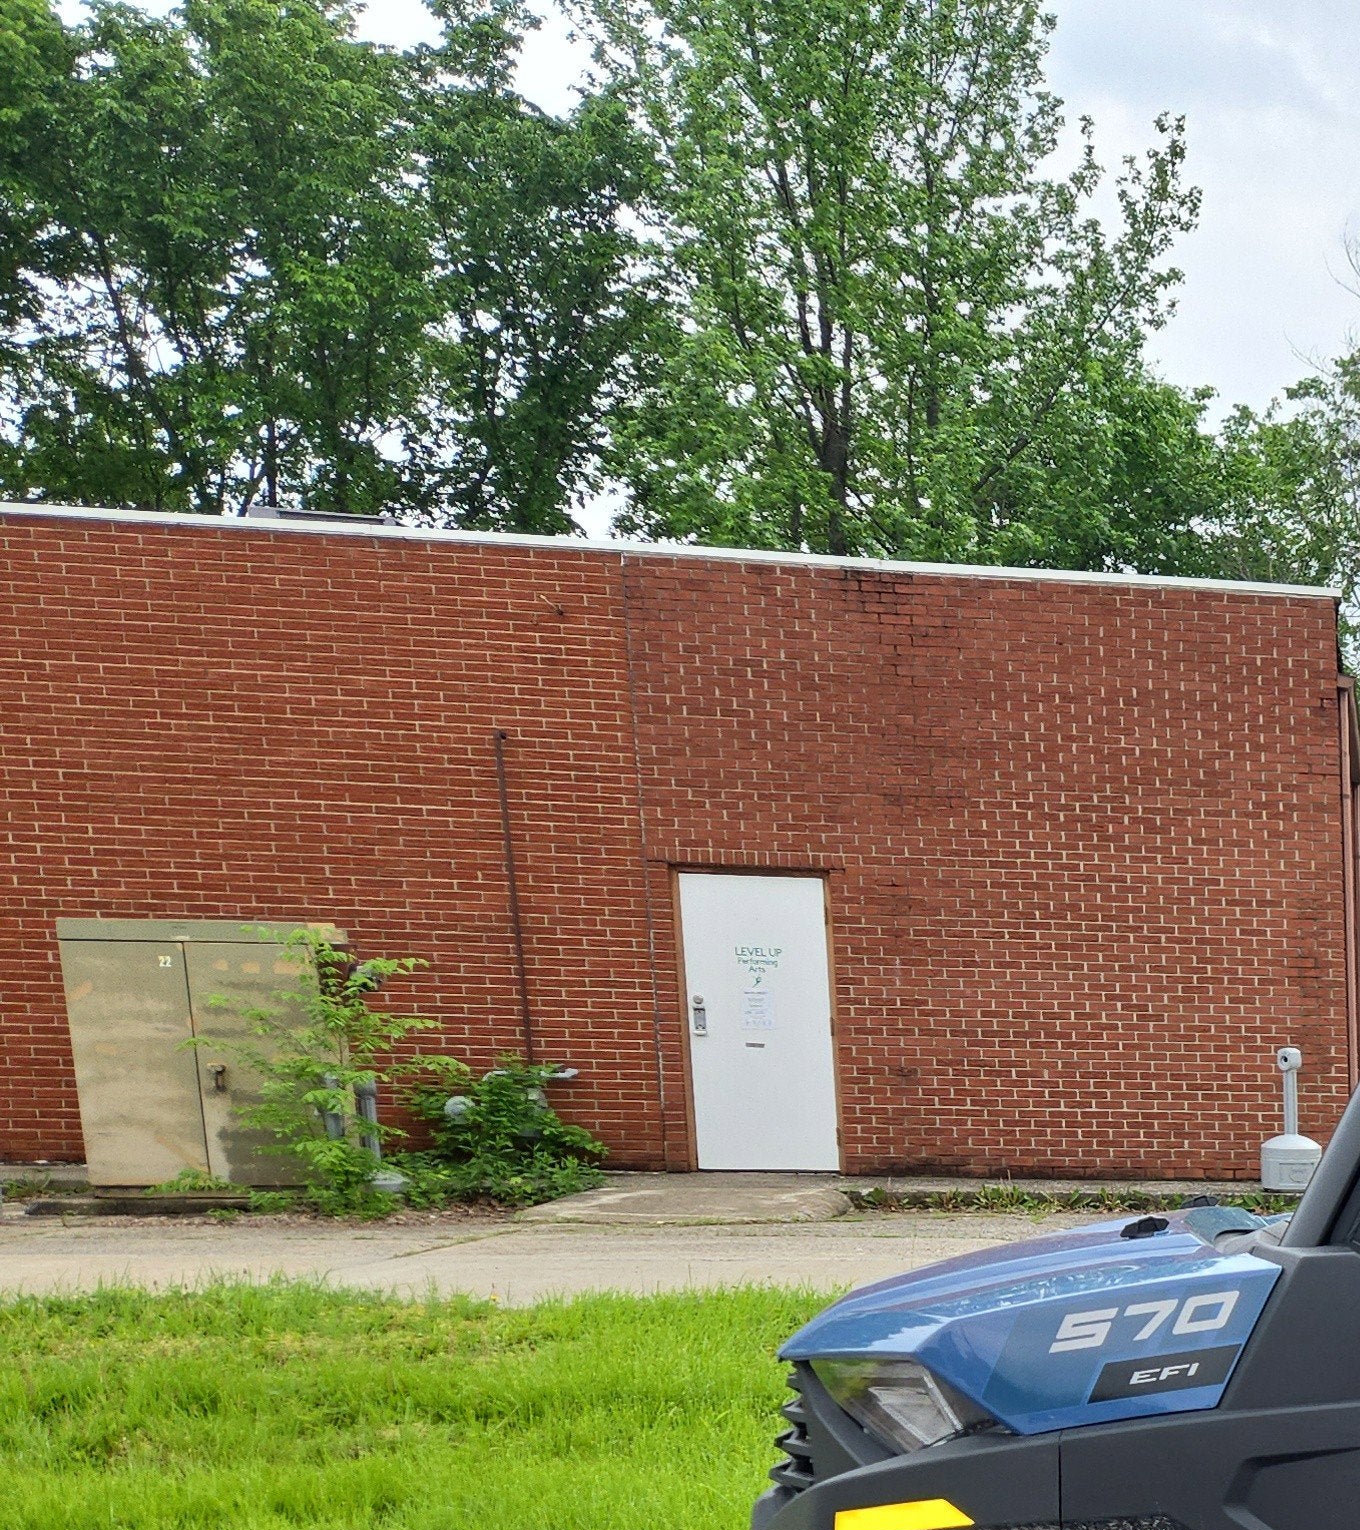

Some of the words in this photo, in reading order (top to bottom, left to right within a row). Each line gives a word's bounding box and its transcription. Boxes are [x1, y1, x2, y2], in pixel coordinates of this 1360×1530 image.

[734, 946, 766, 957] LEVEL
[768, 948, 782, 957] UP
[157, 955, 172, 967] 22
[737, 957, 778, 968] Performing
[748, 965, 766, 973] Arts
[1049, 1290, 1240, 1354] 570
[1128, 1362, 1201, 1385] EFI
